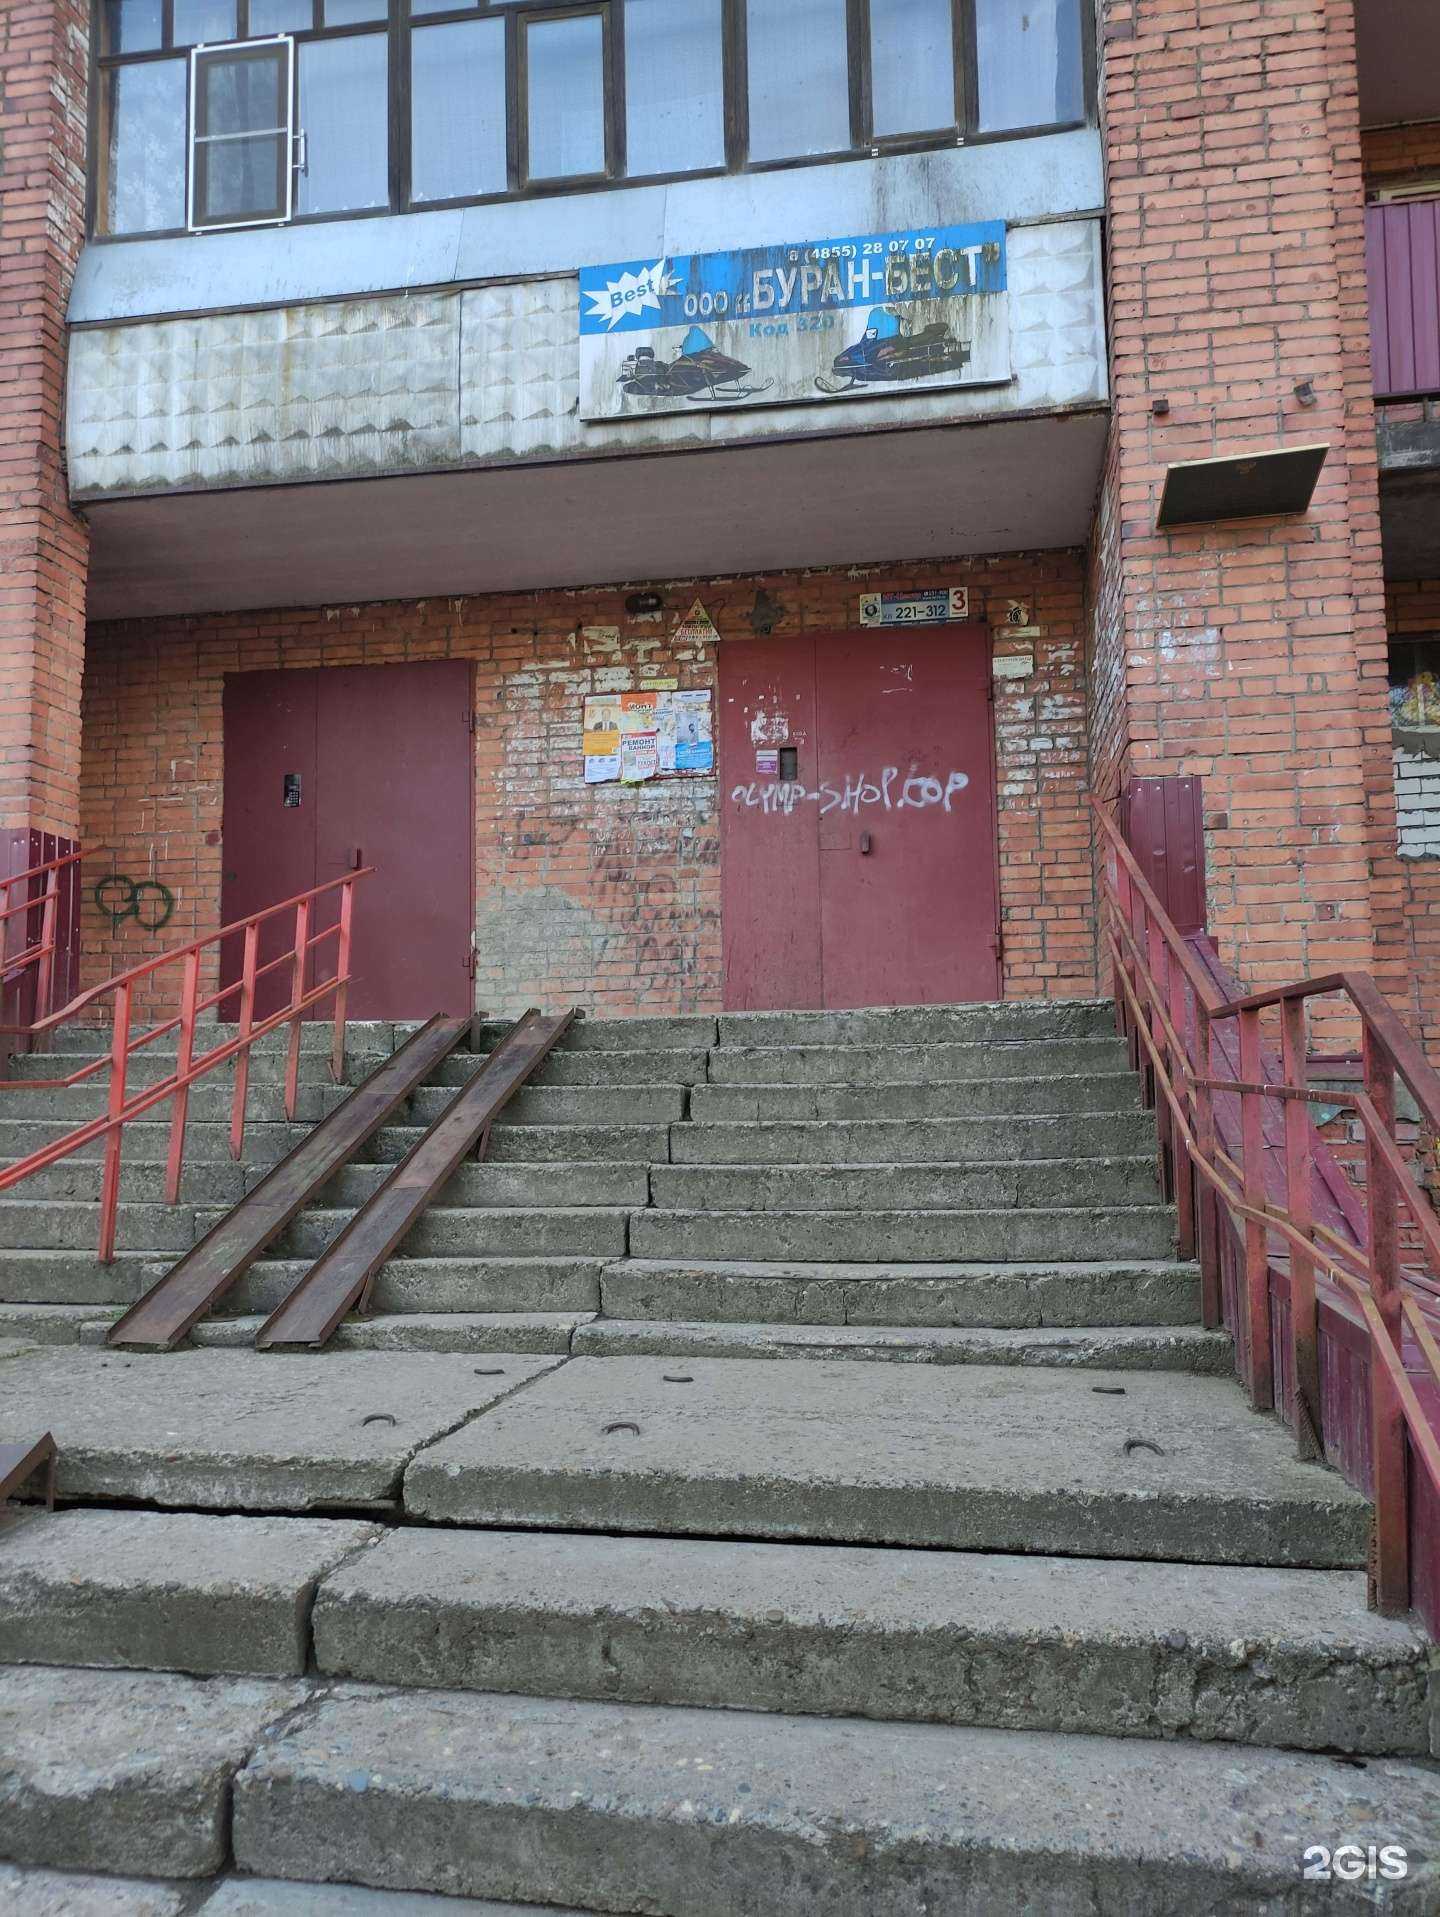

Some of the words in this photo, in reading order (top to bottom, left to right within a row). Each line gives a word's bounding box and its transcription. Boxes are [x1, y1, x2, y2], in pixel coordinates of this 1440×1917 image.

[863, 241, 883, 255] 28
[889, 239, 909, 252] 07
[914, 237, 936, 250] 07
[609, 279, 655, 308] Best
[684, 291, 728, 317] ООО
[952, 589, 966, 610] 3
[895, 604, 947, 619] 221-312
[622, 738, 656, 747] РЕМОНТ
